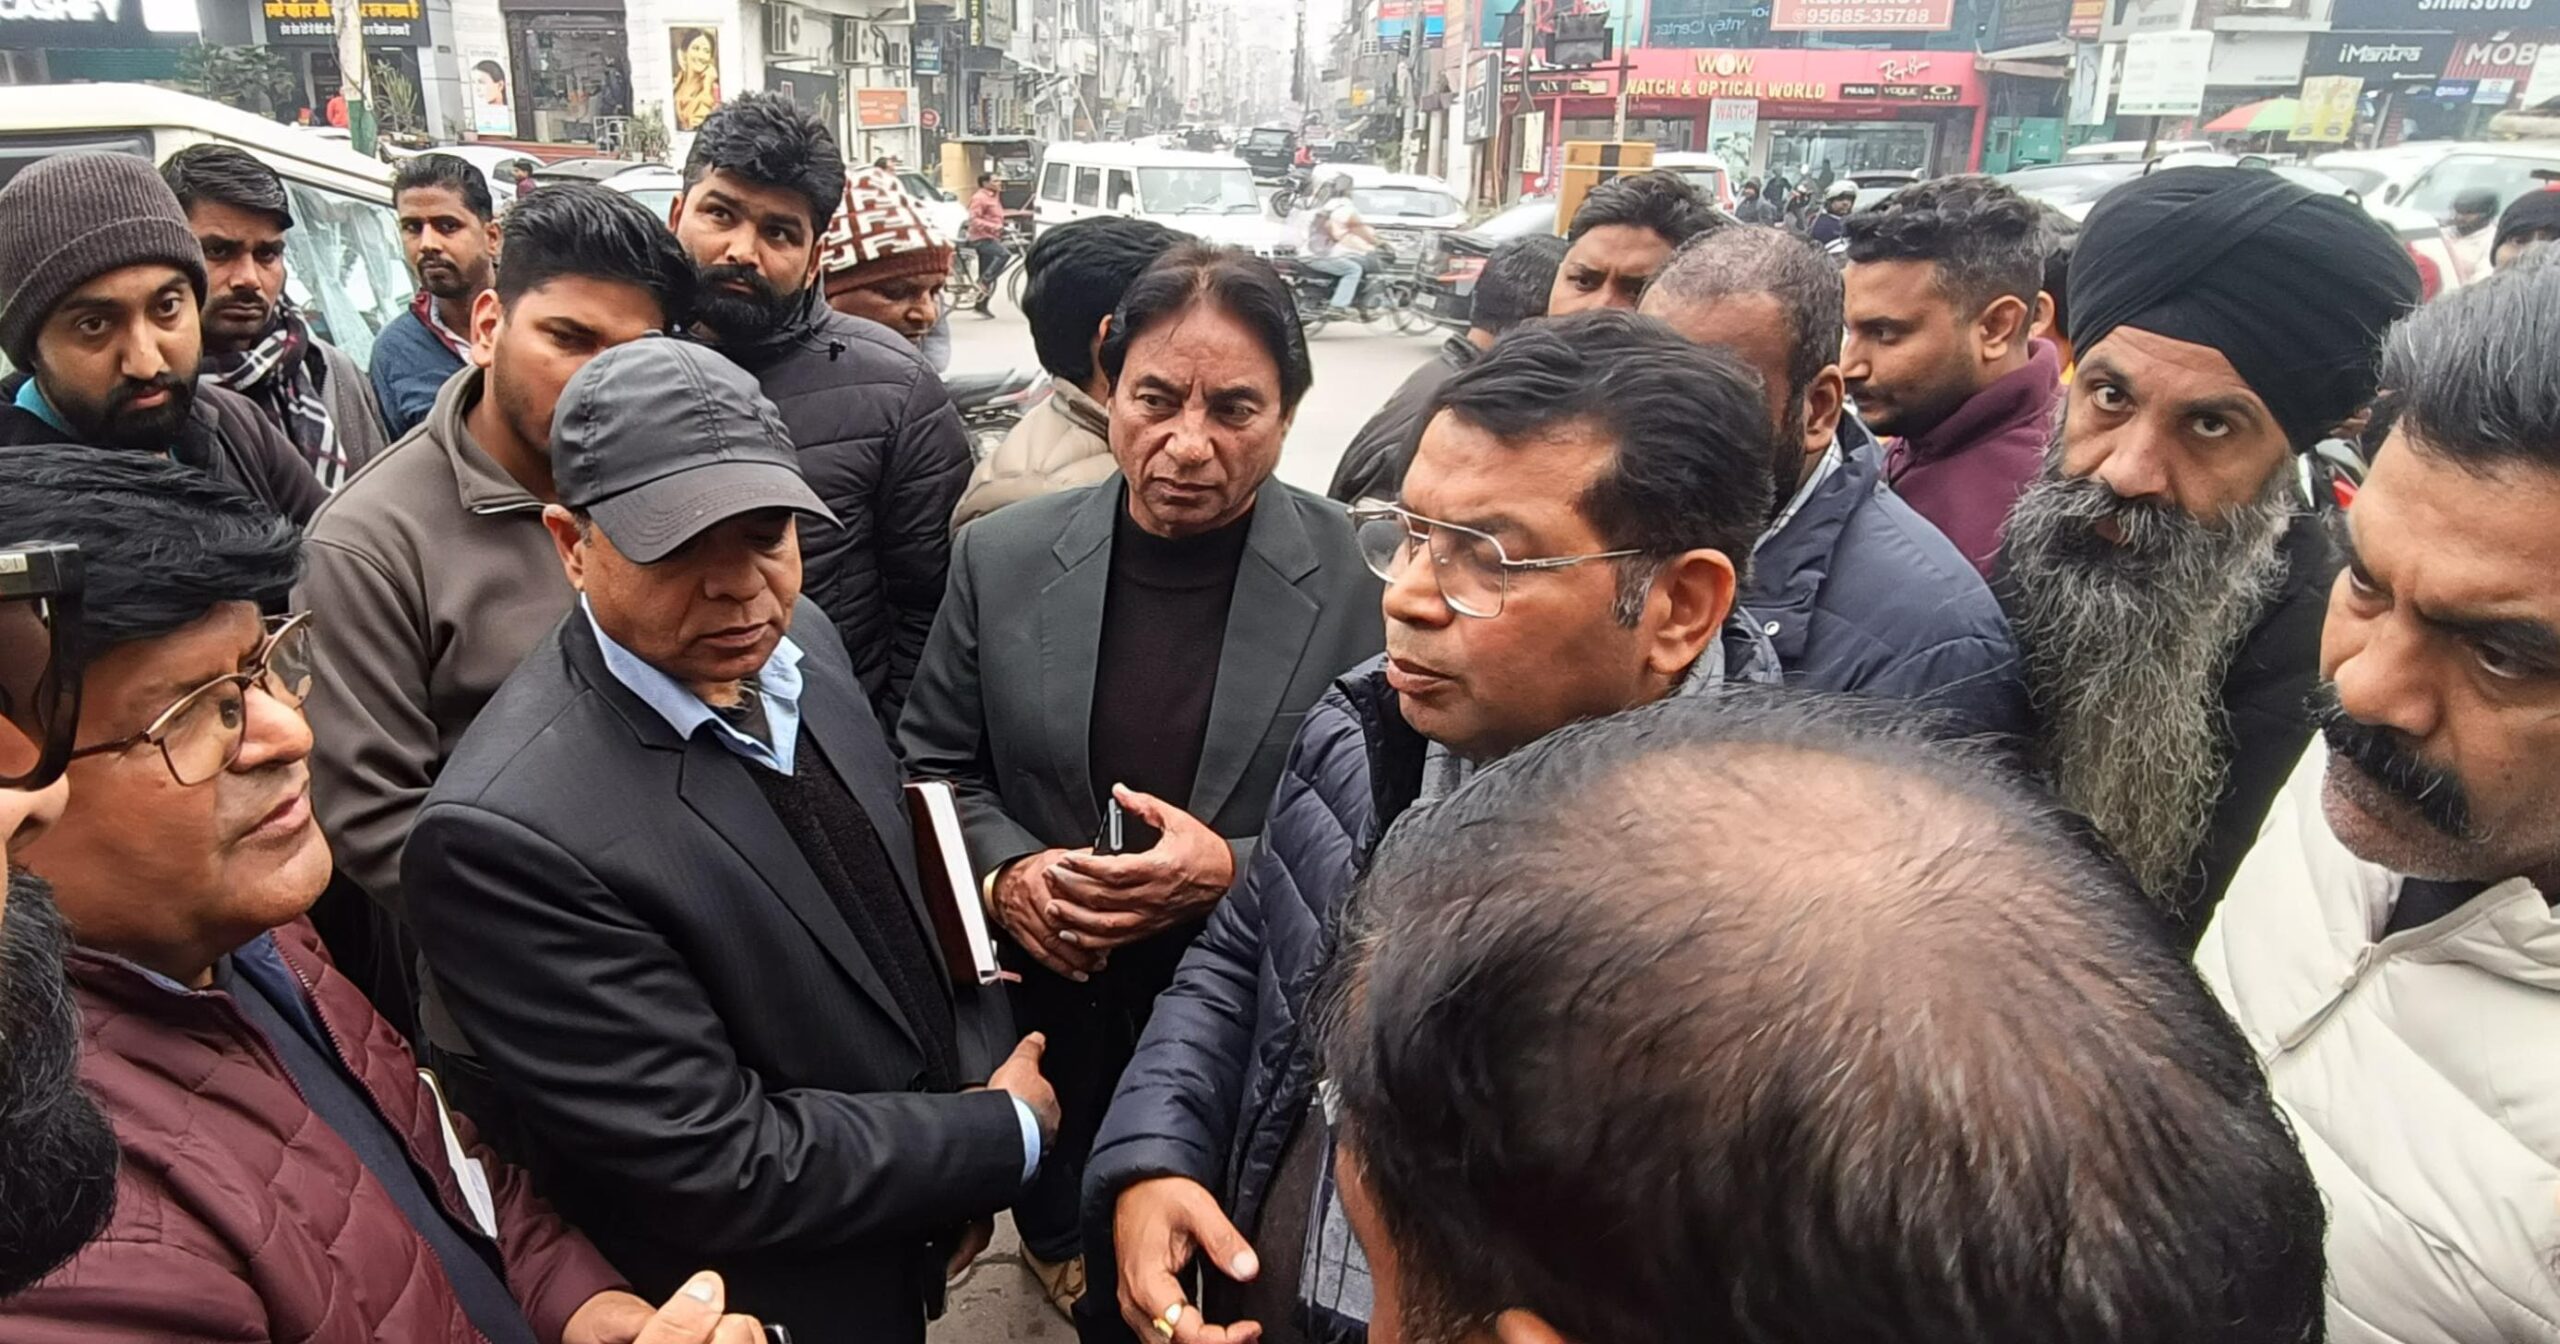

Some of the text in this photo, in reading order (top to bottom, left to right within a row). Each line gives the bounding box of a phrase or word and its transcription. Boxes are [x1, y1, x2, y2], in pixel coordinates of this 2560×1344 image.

[1681, 80, 1692, 95] &
[1698, 80, 1762, 97] OPTICAL
[1768, 82, 1826, 98] WORLD
[1844, 86, 1876, 95] PRADA
[1884, 87, 1918, 96] VOGUE
[1715, 103, 1756, 120] WATCH
